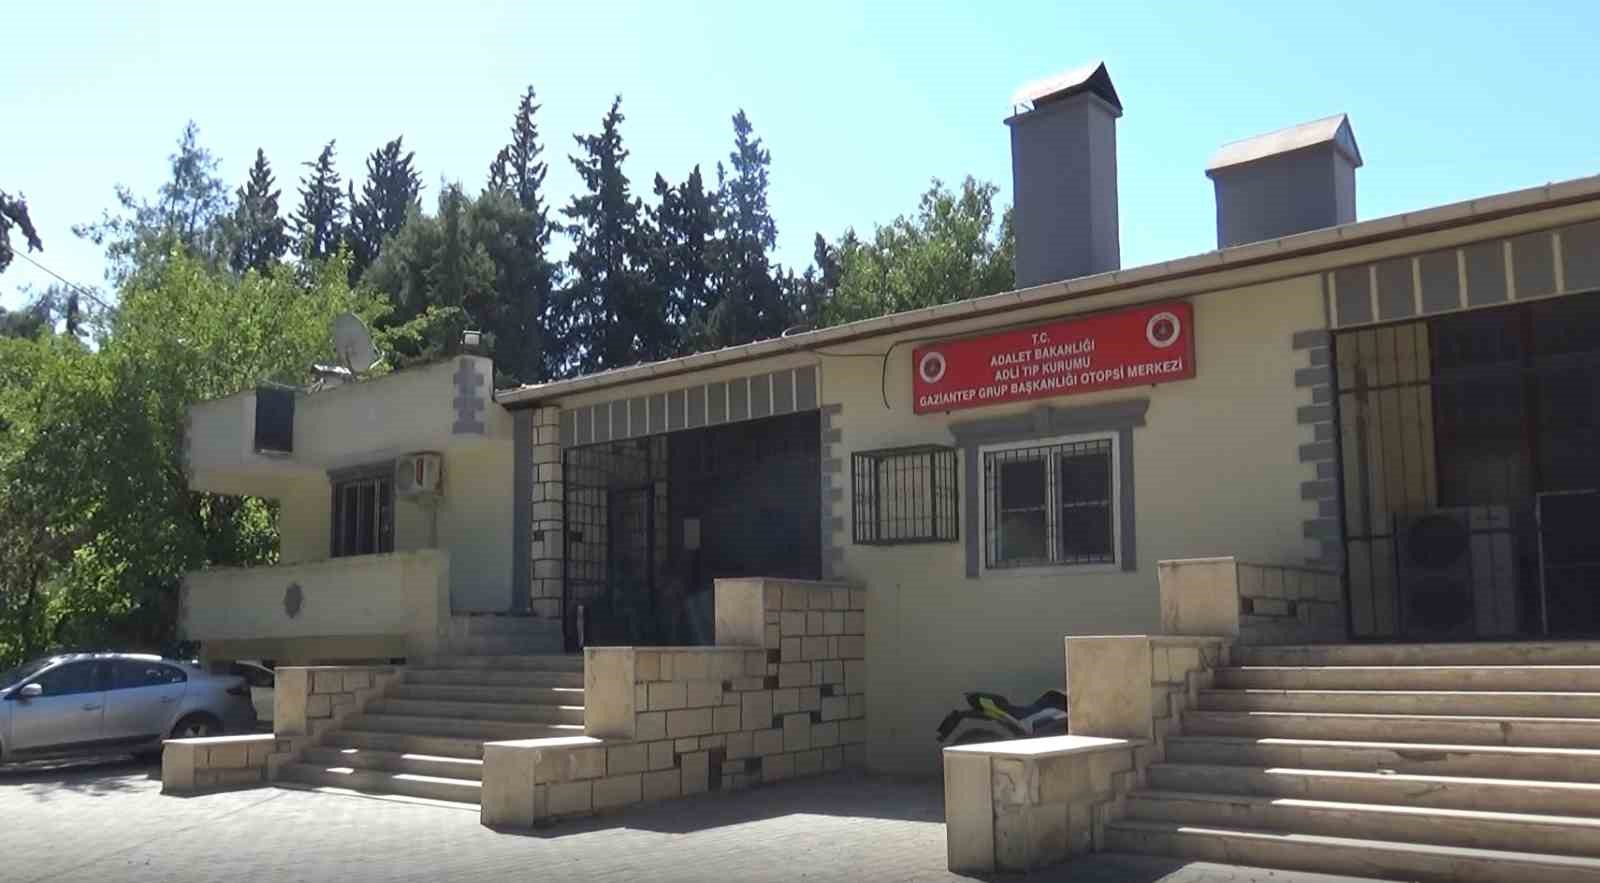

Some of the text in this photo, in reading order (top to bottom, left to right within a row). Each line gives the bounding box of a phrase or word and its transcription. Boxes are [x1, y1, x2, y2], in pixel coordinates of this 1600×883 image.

[1032, 332, 1050, 345] T.C.
[990, 338, 1095, 367] ADALET BAKANLIĞI
[920, 357, 1183, 407] GAZİANTEP GRUP BAŞKANLIĞI OTOPSİ MERKEZİ
[995, 356, 1090, 382] ADLİ TIP KURUMU
